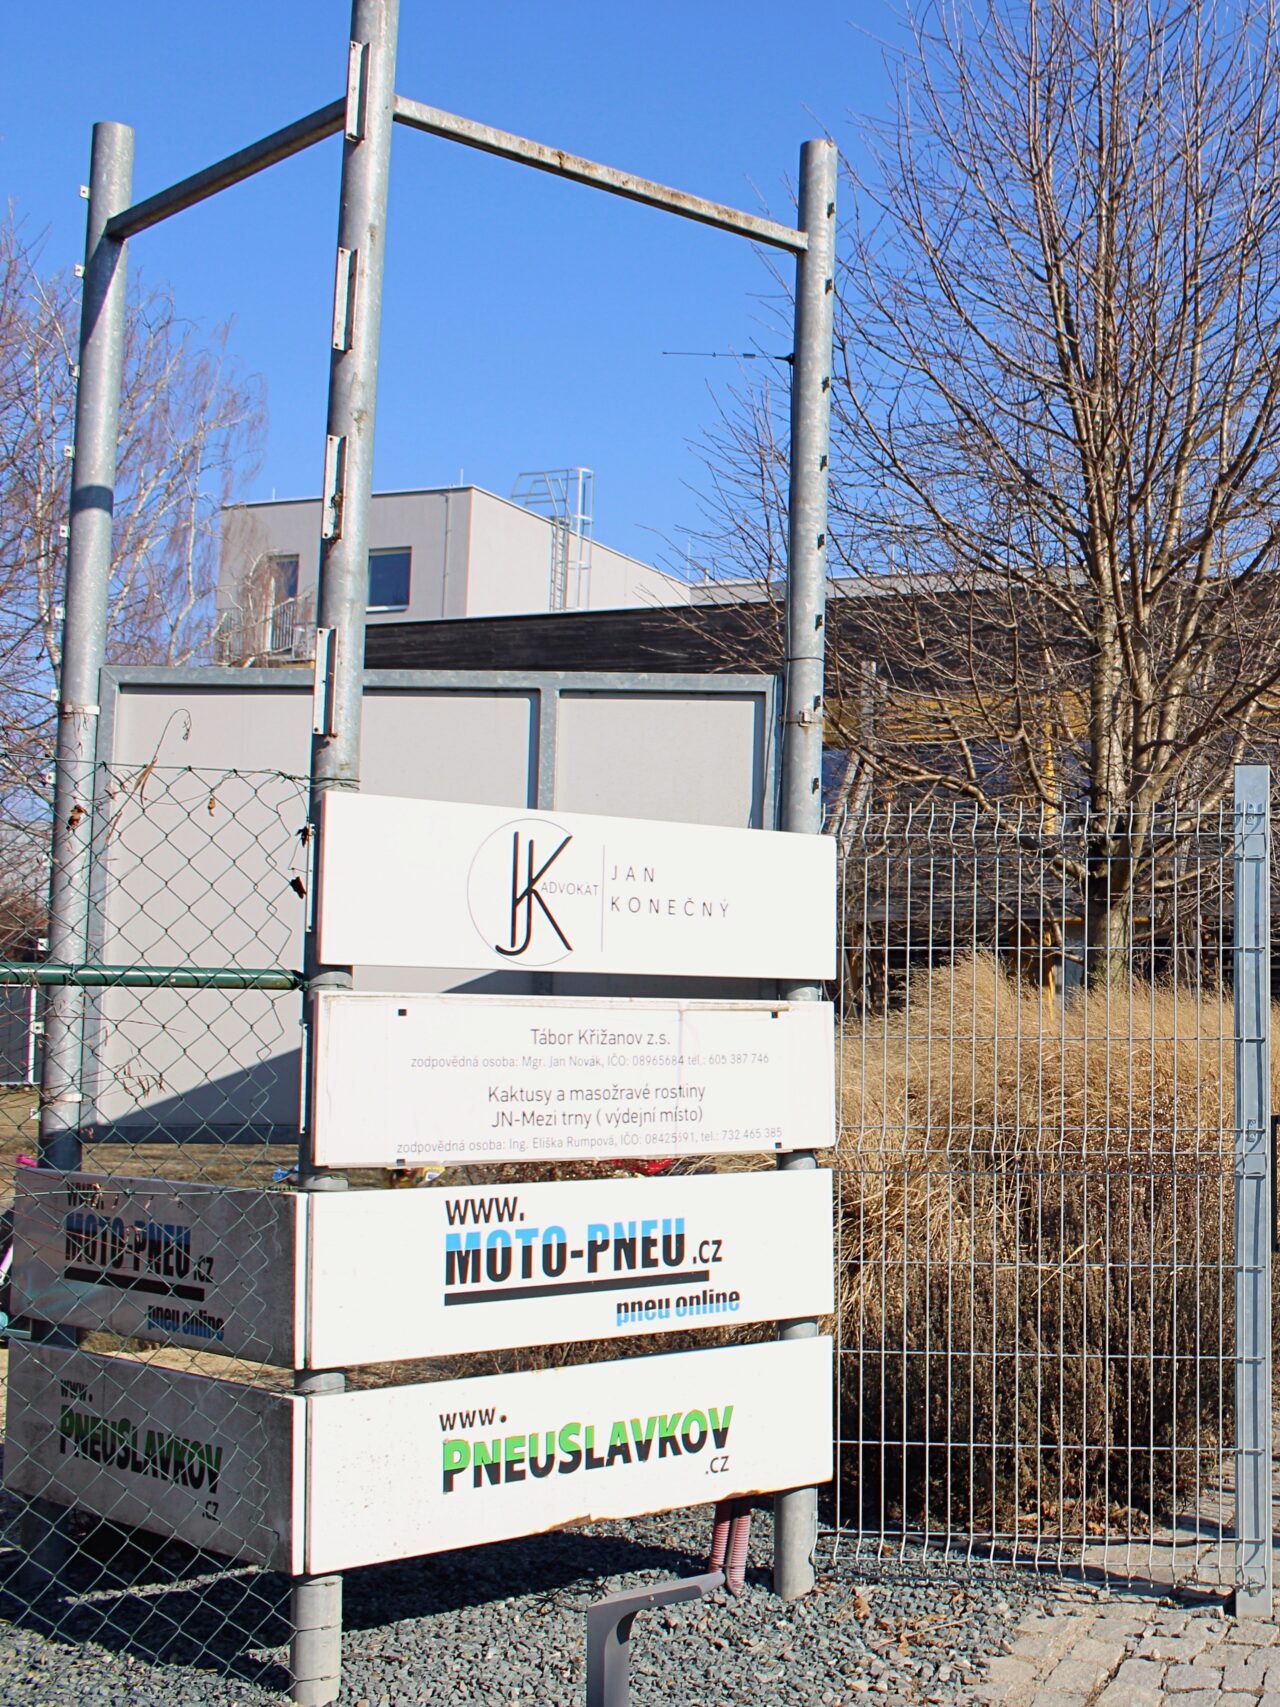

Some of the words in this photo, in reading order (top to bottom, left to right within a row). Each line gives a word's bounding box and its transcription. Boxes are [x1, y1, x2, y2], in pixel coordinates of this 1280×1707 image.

[611, 864, 654, 882] JAN
[611, 896, 729, 918] KONEČNÝ
[531, 1028, 574, 1045] Tábor
[578, 1028, 643, 1045] Křižanov
[647, 1032, 671, 1045] z.s.
[410, 1055, 479, 1069] zodpovědná
[482, 1055, 518, 1068] osoba:
[521, 1055, 546, 1070] Mgr.
[549, 1055, 566, 1068] Jan
[607, 1053, 630, 1067] IČO:
[730, 1053, 748, 1065] 387
[751, 1053, 769, 1064] 746
[488, 1085, 552, 1106] Kaktusy
[557, 1088, 565, 1101] a
[570, 1082, 650, 1101] masožravé
[654, 1083, 706, 1102] rostliny
[491, 1109, 557, 1128] JN-Mezi
[562, 1109, 592, 1129] trny
[605, 1105, 656, 1128] výdejní
[660, 1104, 704, 1123] místo)
[396, 1139, 465, 1155] zodpovědná
[469, 1137, 505, 1151] osoba:
[509, 1137, 528, 1152] Ing.
[533, 1137, 563, 1149] Eliška
[620, 1131, 643, 1146] IČO:
[722, 1129, 740, 1141] 732
[743, 1128, 761, 1140] 465
[764, 1127, 782, 1139] 385
[616, 1296, 671, 1327] pneu
[675, 1289, 740, 1318] online
[59, 1404, 223, 1494] PNEUSLAVKOV
[442, 1405, 734, 1495] PNEUSLAVKOV
